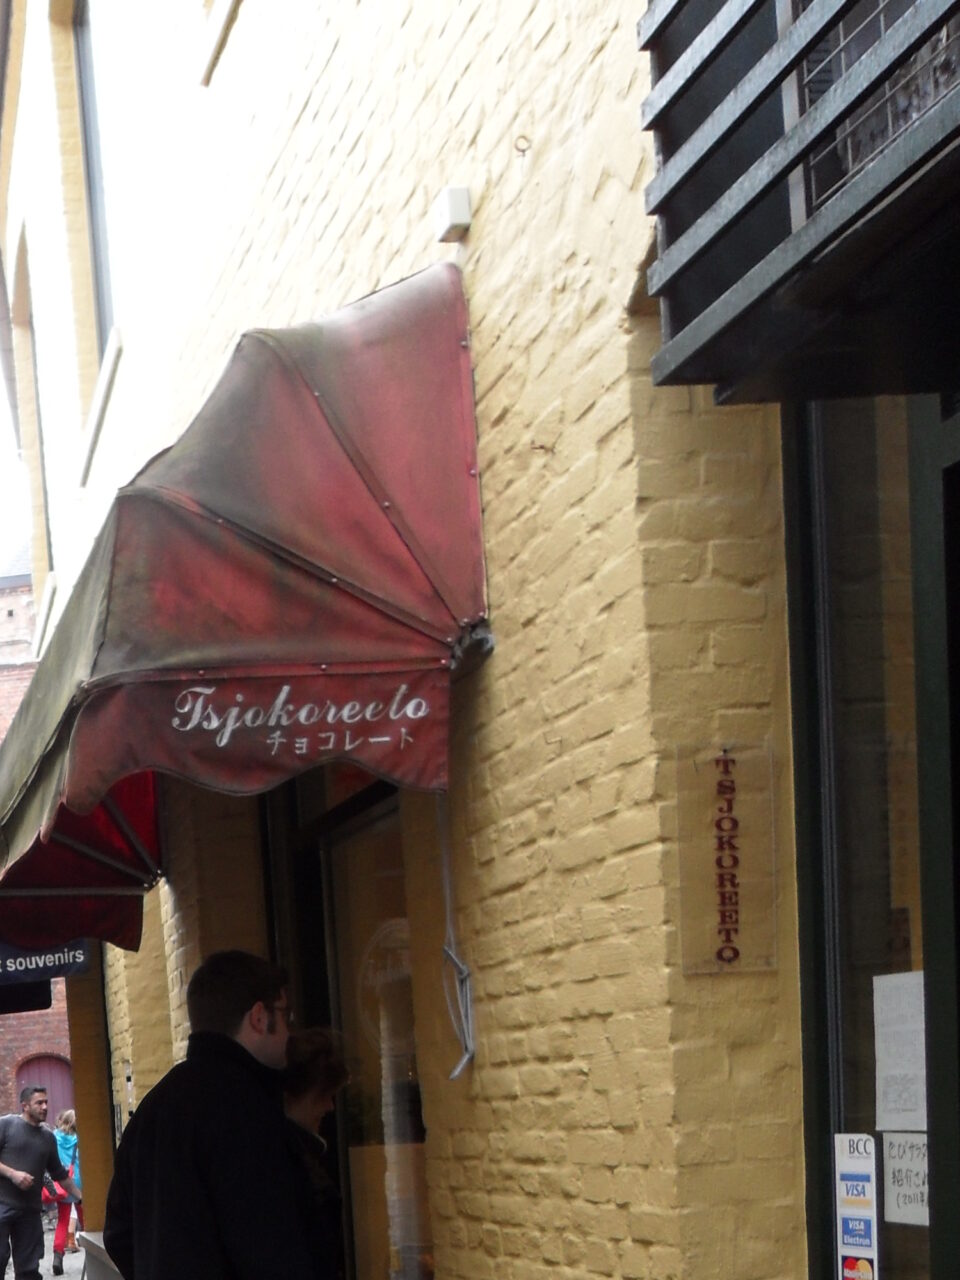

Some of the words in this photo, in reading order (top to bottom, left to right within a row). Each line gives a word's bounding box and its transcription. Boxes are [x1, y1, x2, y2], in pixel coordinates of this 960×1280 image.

[266, 727, 415, 756] チョコレート
[714, 757, 740, 963] TSJOKOREETO
[6, 947, 84, 972] souvenirs
[848, 1138, 872, 1156] BCC
[845, 1183, 866, 1198] VISA
[848, 1219, 865, 1230] VISA
[843, 1235, 871, 1246] Electron
